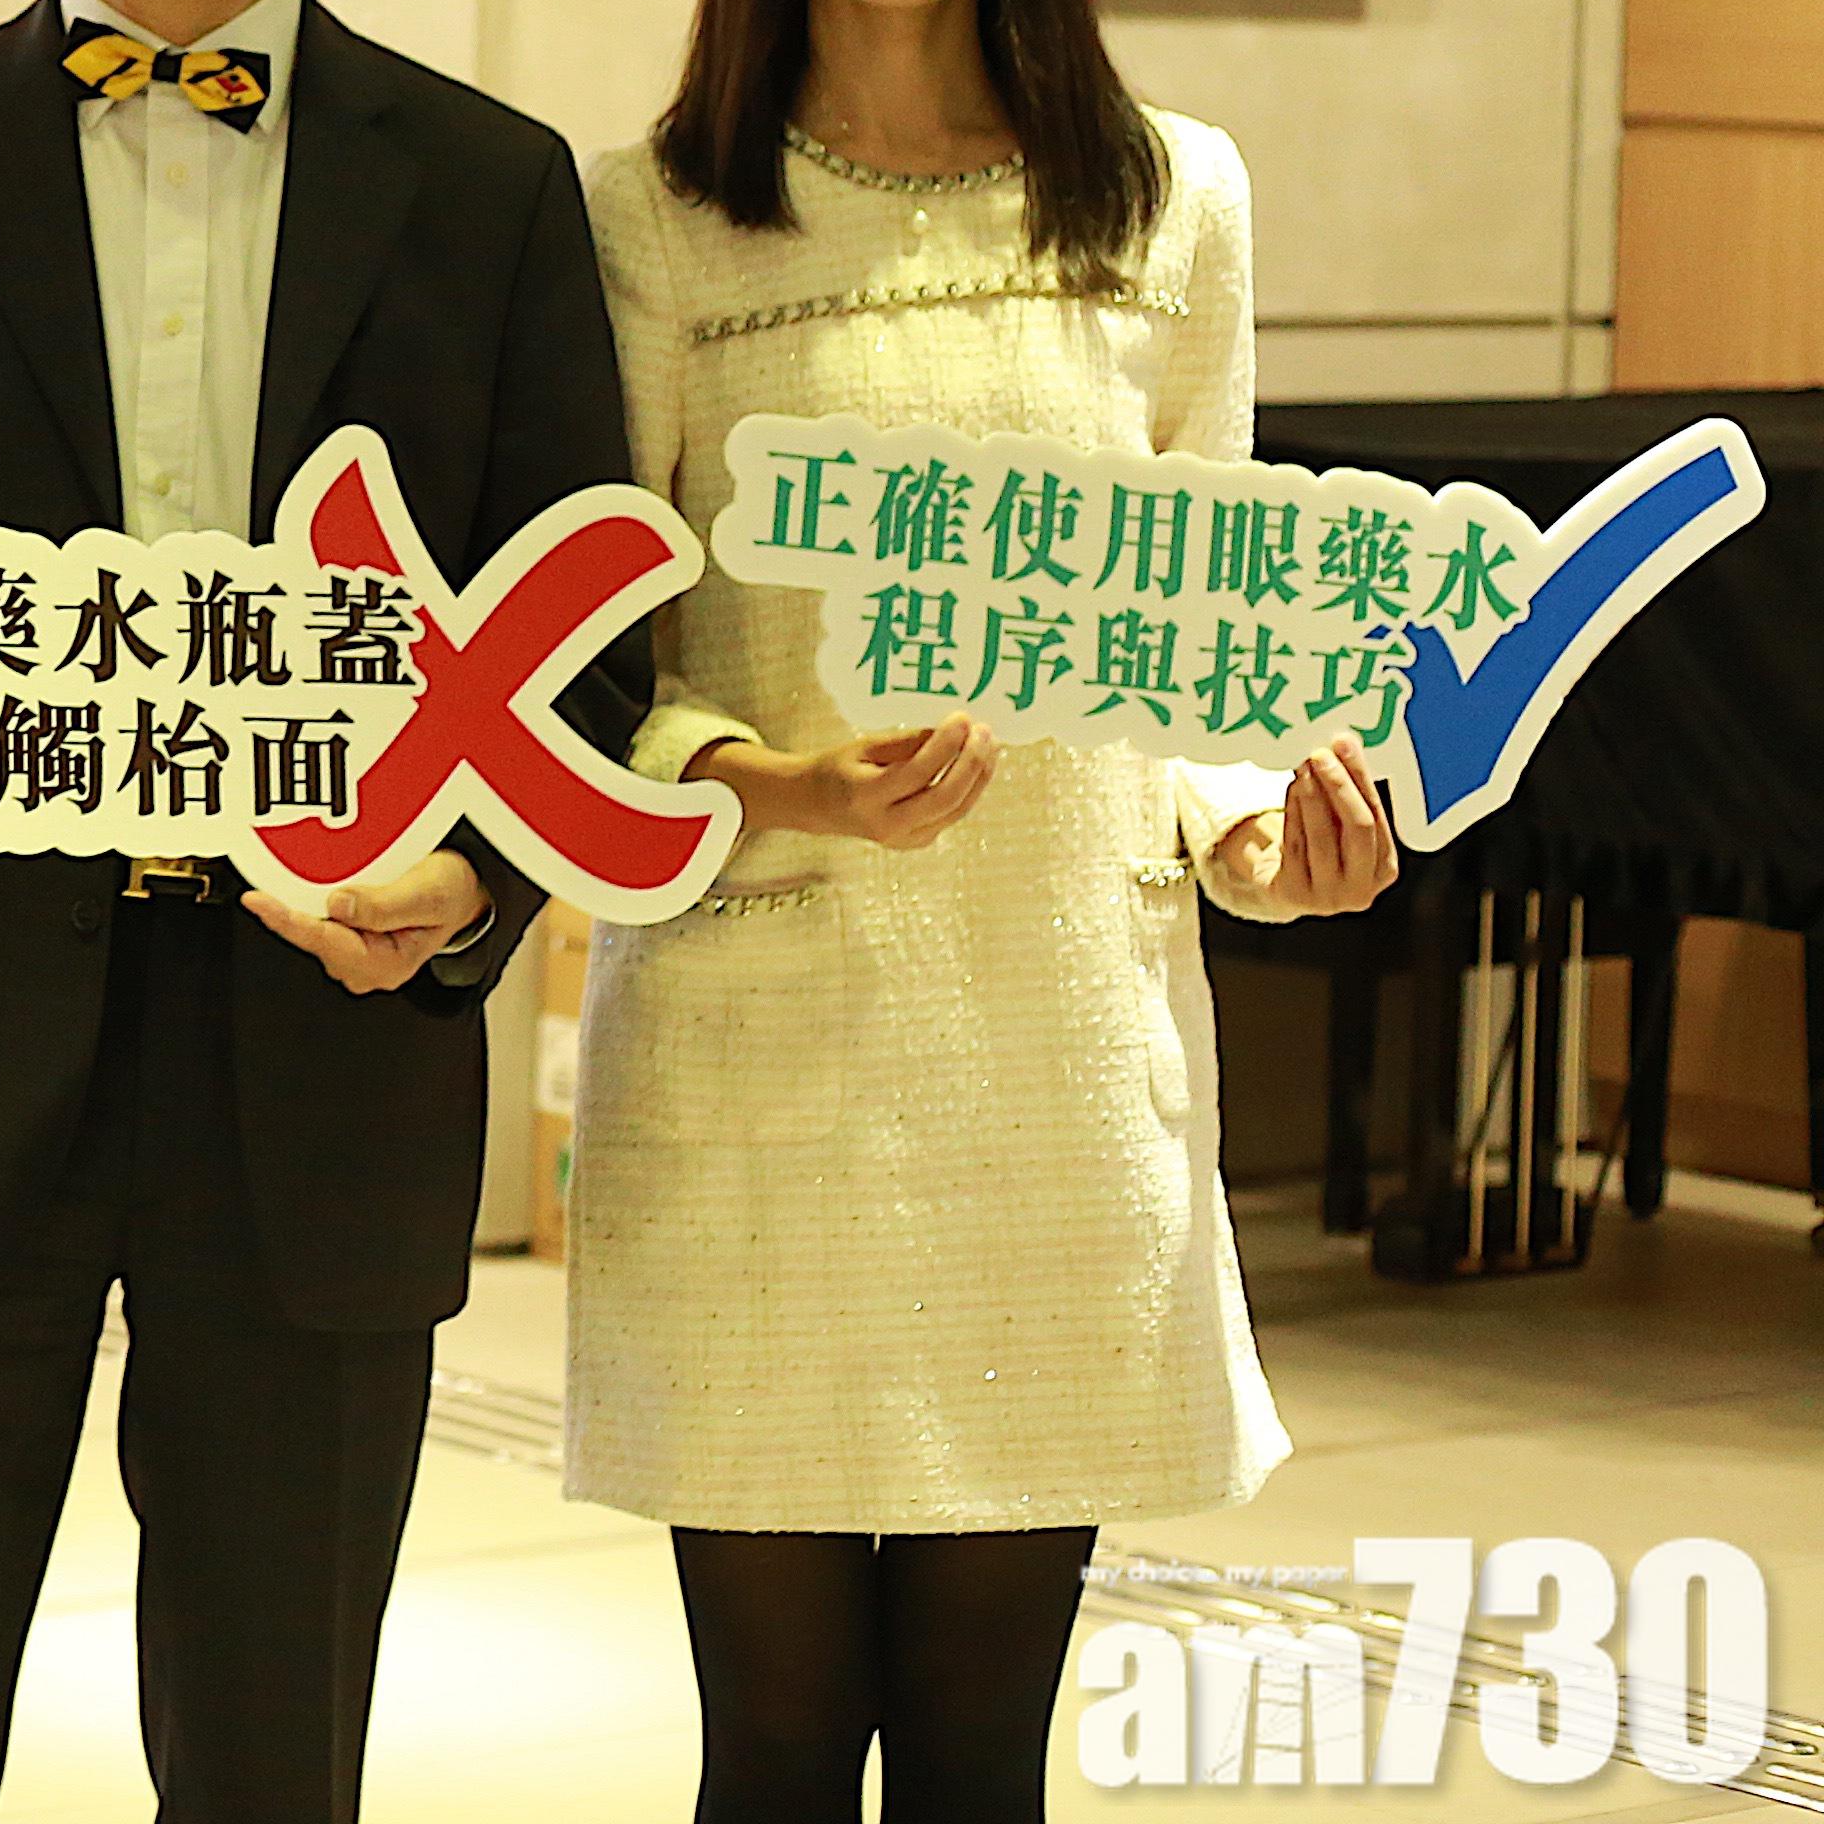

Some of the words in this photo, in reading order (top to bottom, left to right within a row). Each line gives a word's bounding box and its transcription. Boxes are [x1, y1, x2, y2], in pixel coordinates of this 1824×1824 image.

[753, 448, 1518, 630] 正確使用眼藥水
[855, 580, 1406, 747] 程序與技巧
